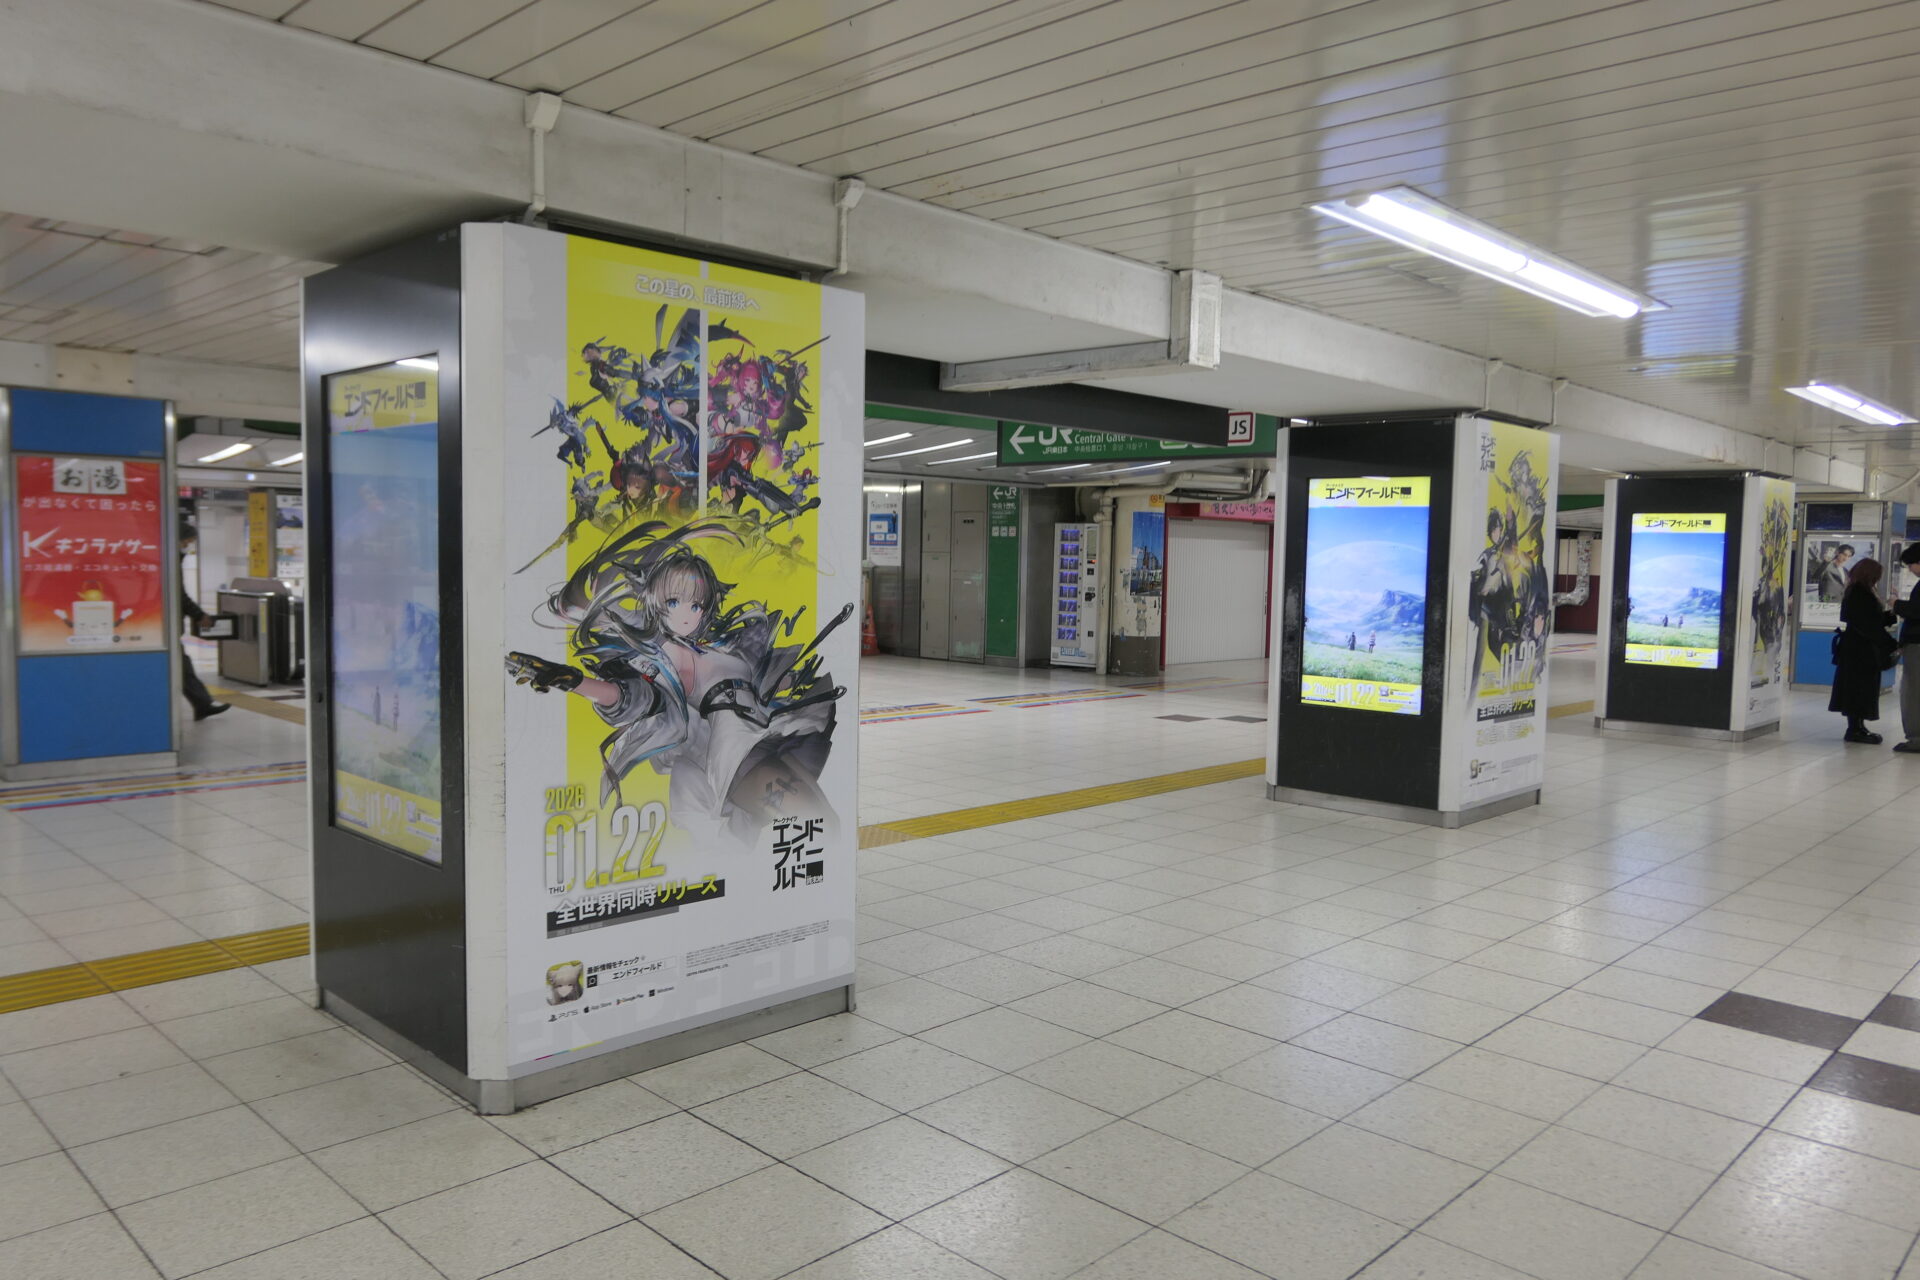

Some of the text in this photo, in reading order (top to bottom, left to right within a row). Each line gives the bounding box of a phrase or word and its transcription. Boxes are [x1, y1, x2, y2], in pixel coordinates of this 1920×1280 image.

[635, 274, 760, 311] この星の、最前線へ
[1231, 420, 1247, 435] JS
[1074, 433, 1104, 444] Central
[60, 466, 120, 490] お湯
[1325, 486, 1400, 499] エンドフィールド
[56, 538, 157, 554] キンライサー
[545, 784, 585, 813] 2026
[544, 802, 667, 891] 01.22
[548, 885, 566, 895] THU
[554, 874, 718, 924] 全世界同時リリース
[612, 961, 663, 980] エンドフィールド
